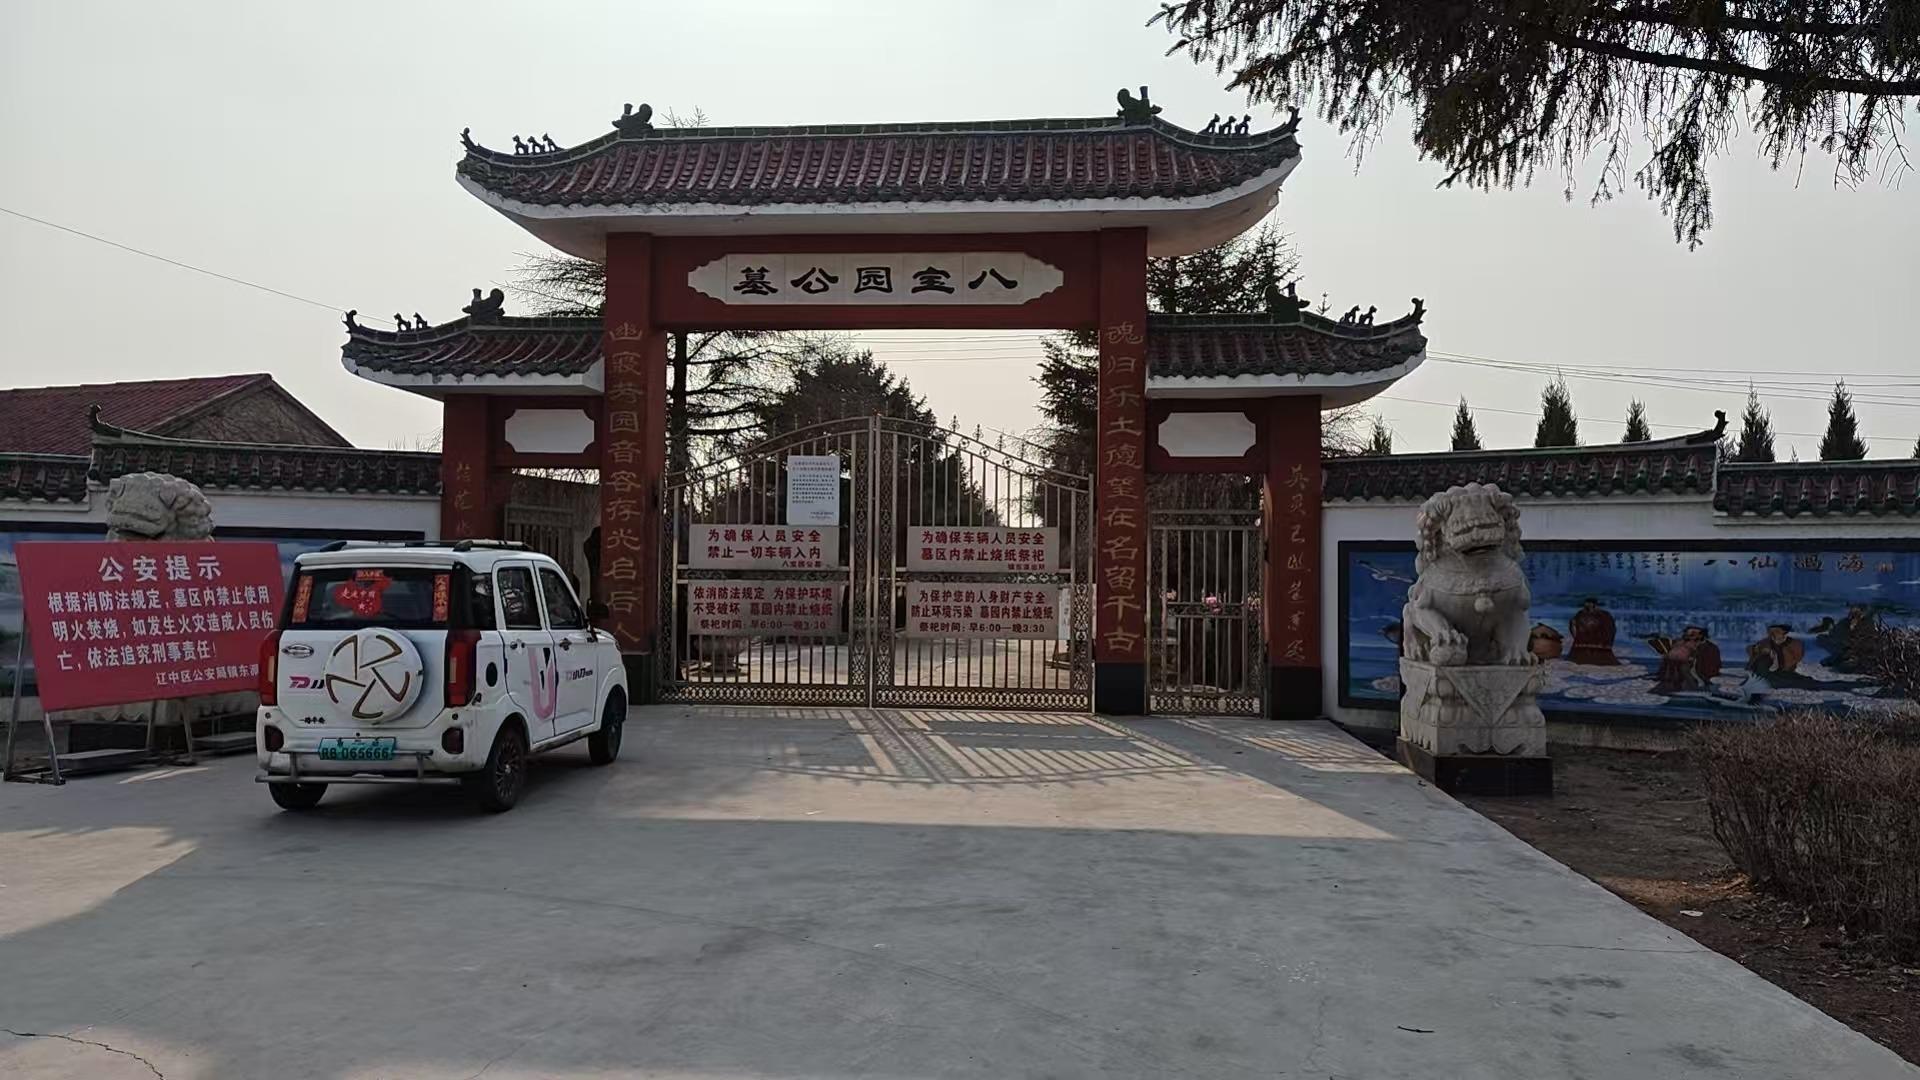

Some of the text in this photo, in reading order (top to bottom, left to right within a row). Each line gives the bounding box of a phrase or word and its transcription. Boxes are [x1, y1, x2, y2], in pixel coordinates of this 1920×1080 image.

[708, 529, 821, 542] 为确保人员安全
[922, 531, 1045, 545] 为确保车辆人员安全
[707, 546, 821, 558] 禁止一切车辆入内
[921, 548, 1045, 562] 墓区内禁止烧纸祭祀
[99, 555, 221, 582] 公安提示
[47, 585, 271, 614] 根据消防法规定，墓区内禁止使用
[693, 586, 833, 601] 依消防法规定 为保护环境
[919, 590, 1046, 604] 为保护您的人身财产安全
[693, 603, 741, 615] 不受破坏
[911, 605, 1053, 620] 防止环境污染 墓园内禁止烧纸
[52, 610, 274, 642] 明火焚烧，如发生火灾造成人员伤
